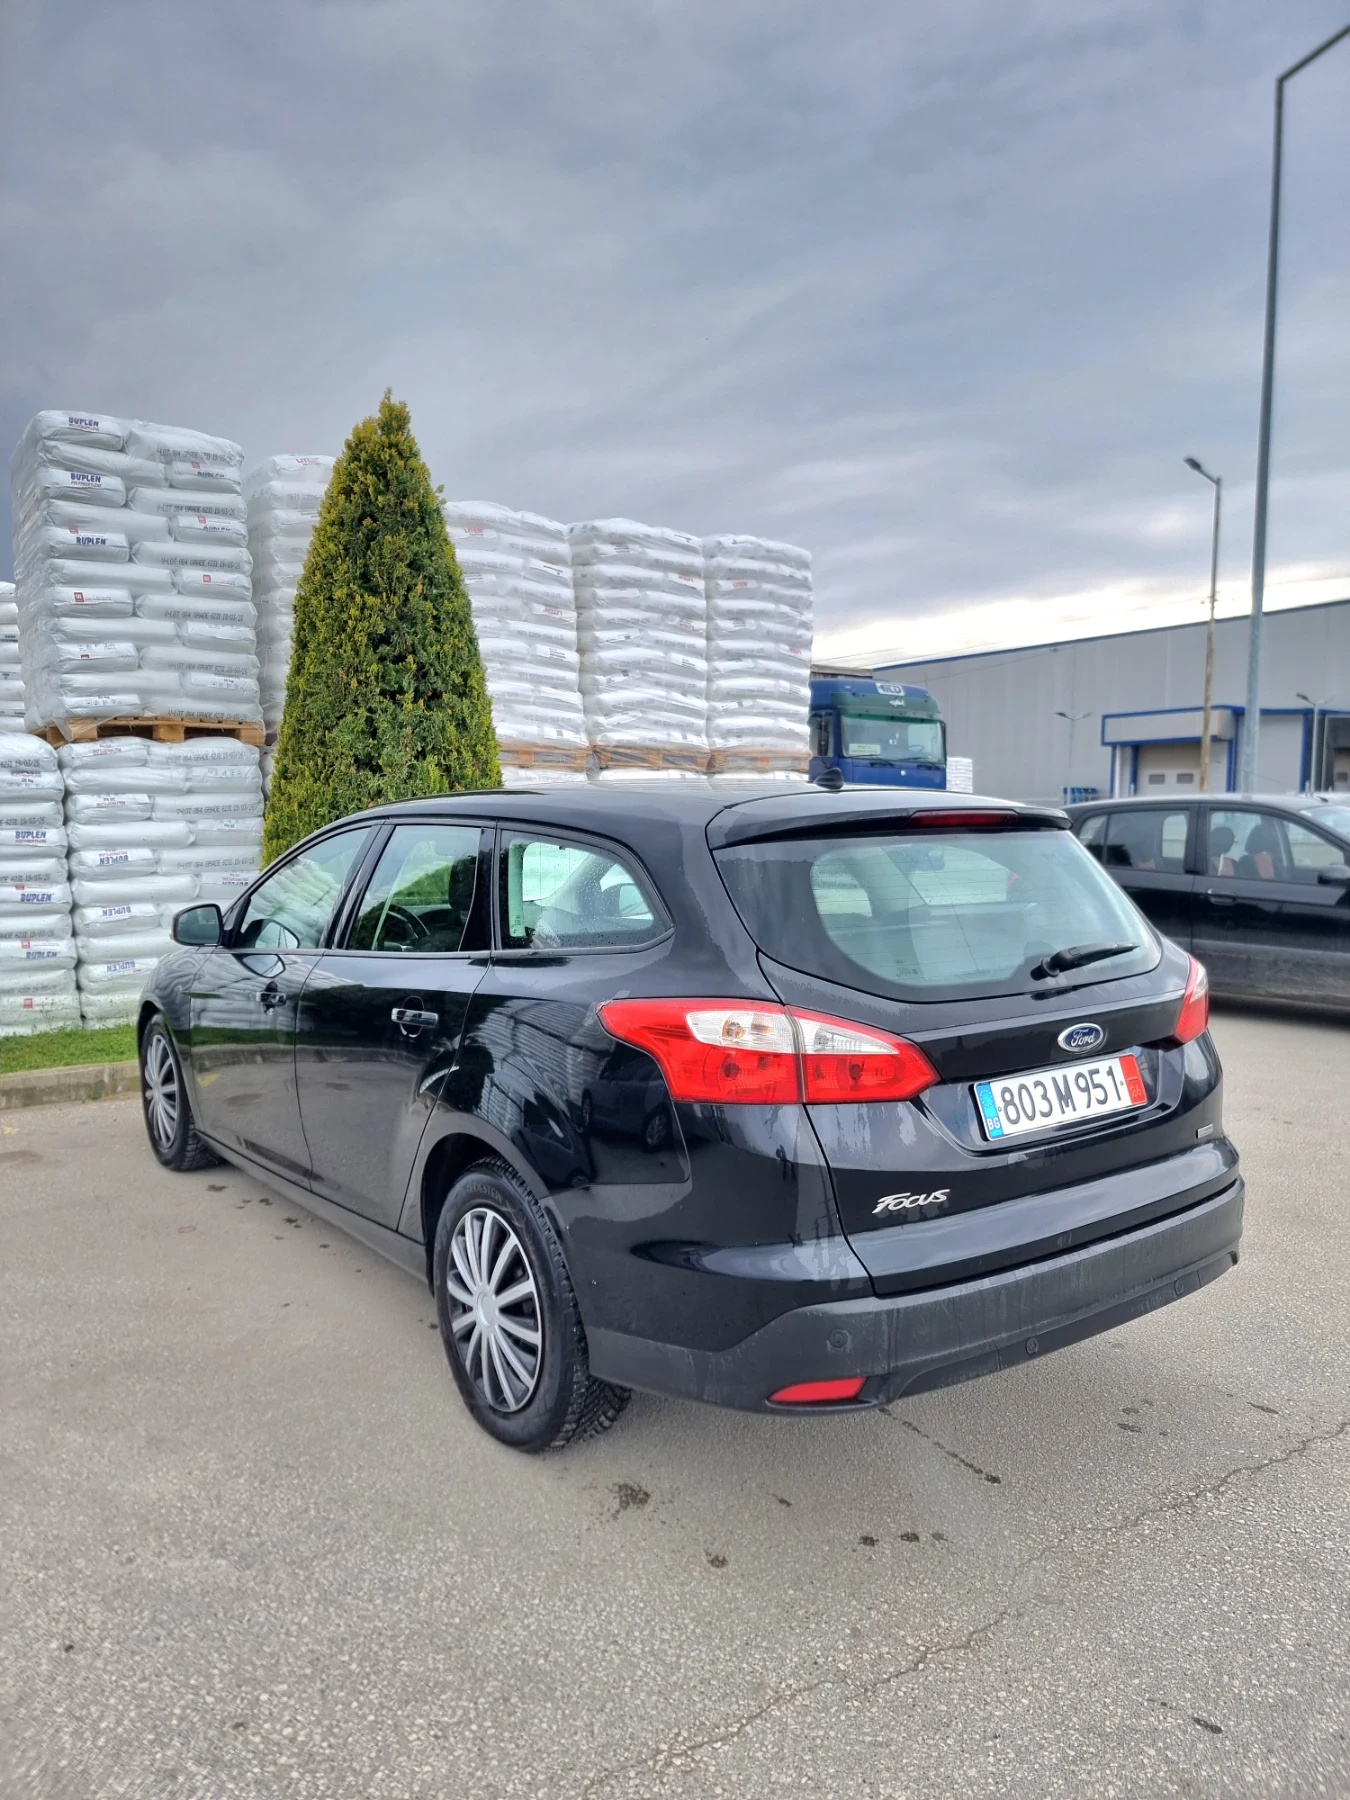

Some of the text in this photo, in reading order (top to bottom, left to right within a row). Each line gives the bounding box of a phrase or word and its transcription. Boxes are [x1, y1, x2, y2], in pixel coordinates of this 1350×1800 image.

[69, 417, 99, 427] BUPLEN
[71, 473, 101, 483] BUPLEN
[15, 831, 46, 839] BUPLEN
[20, 894, 52, 902] BUPLEN
[1070, 1028, 1096, 1046] Ford
[986, 1116, 1001, 1130] BG
